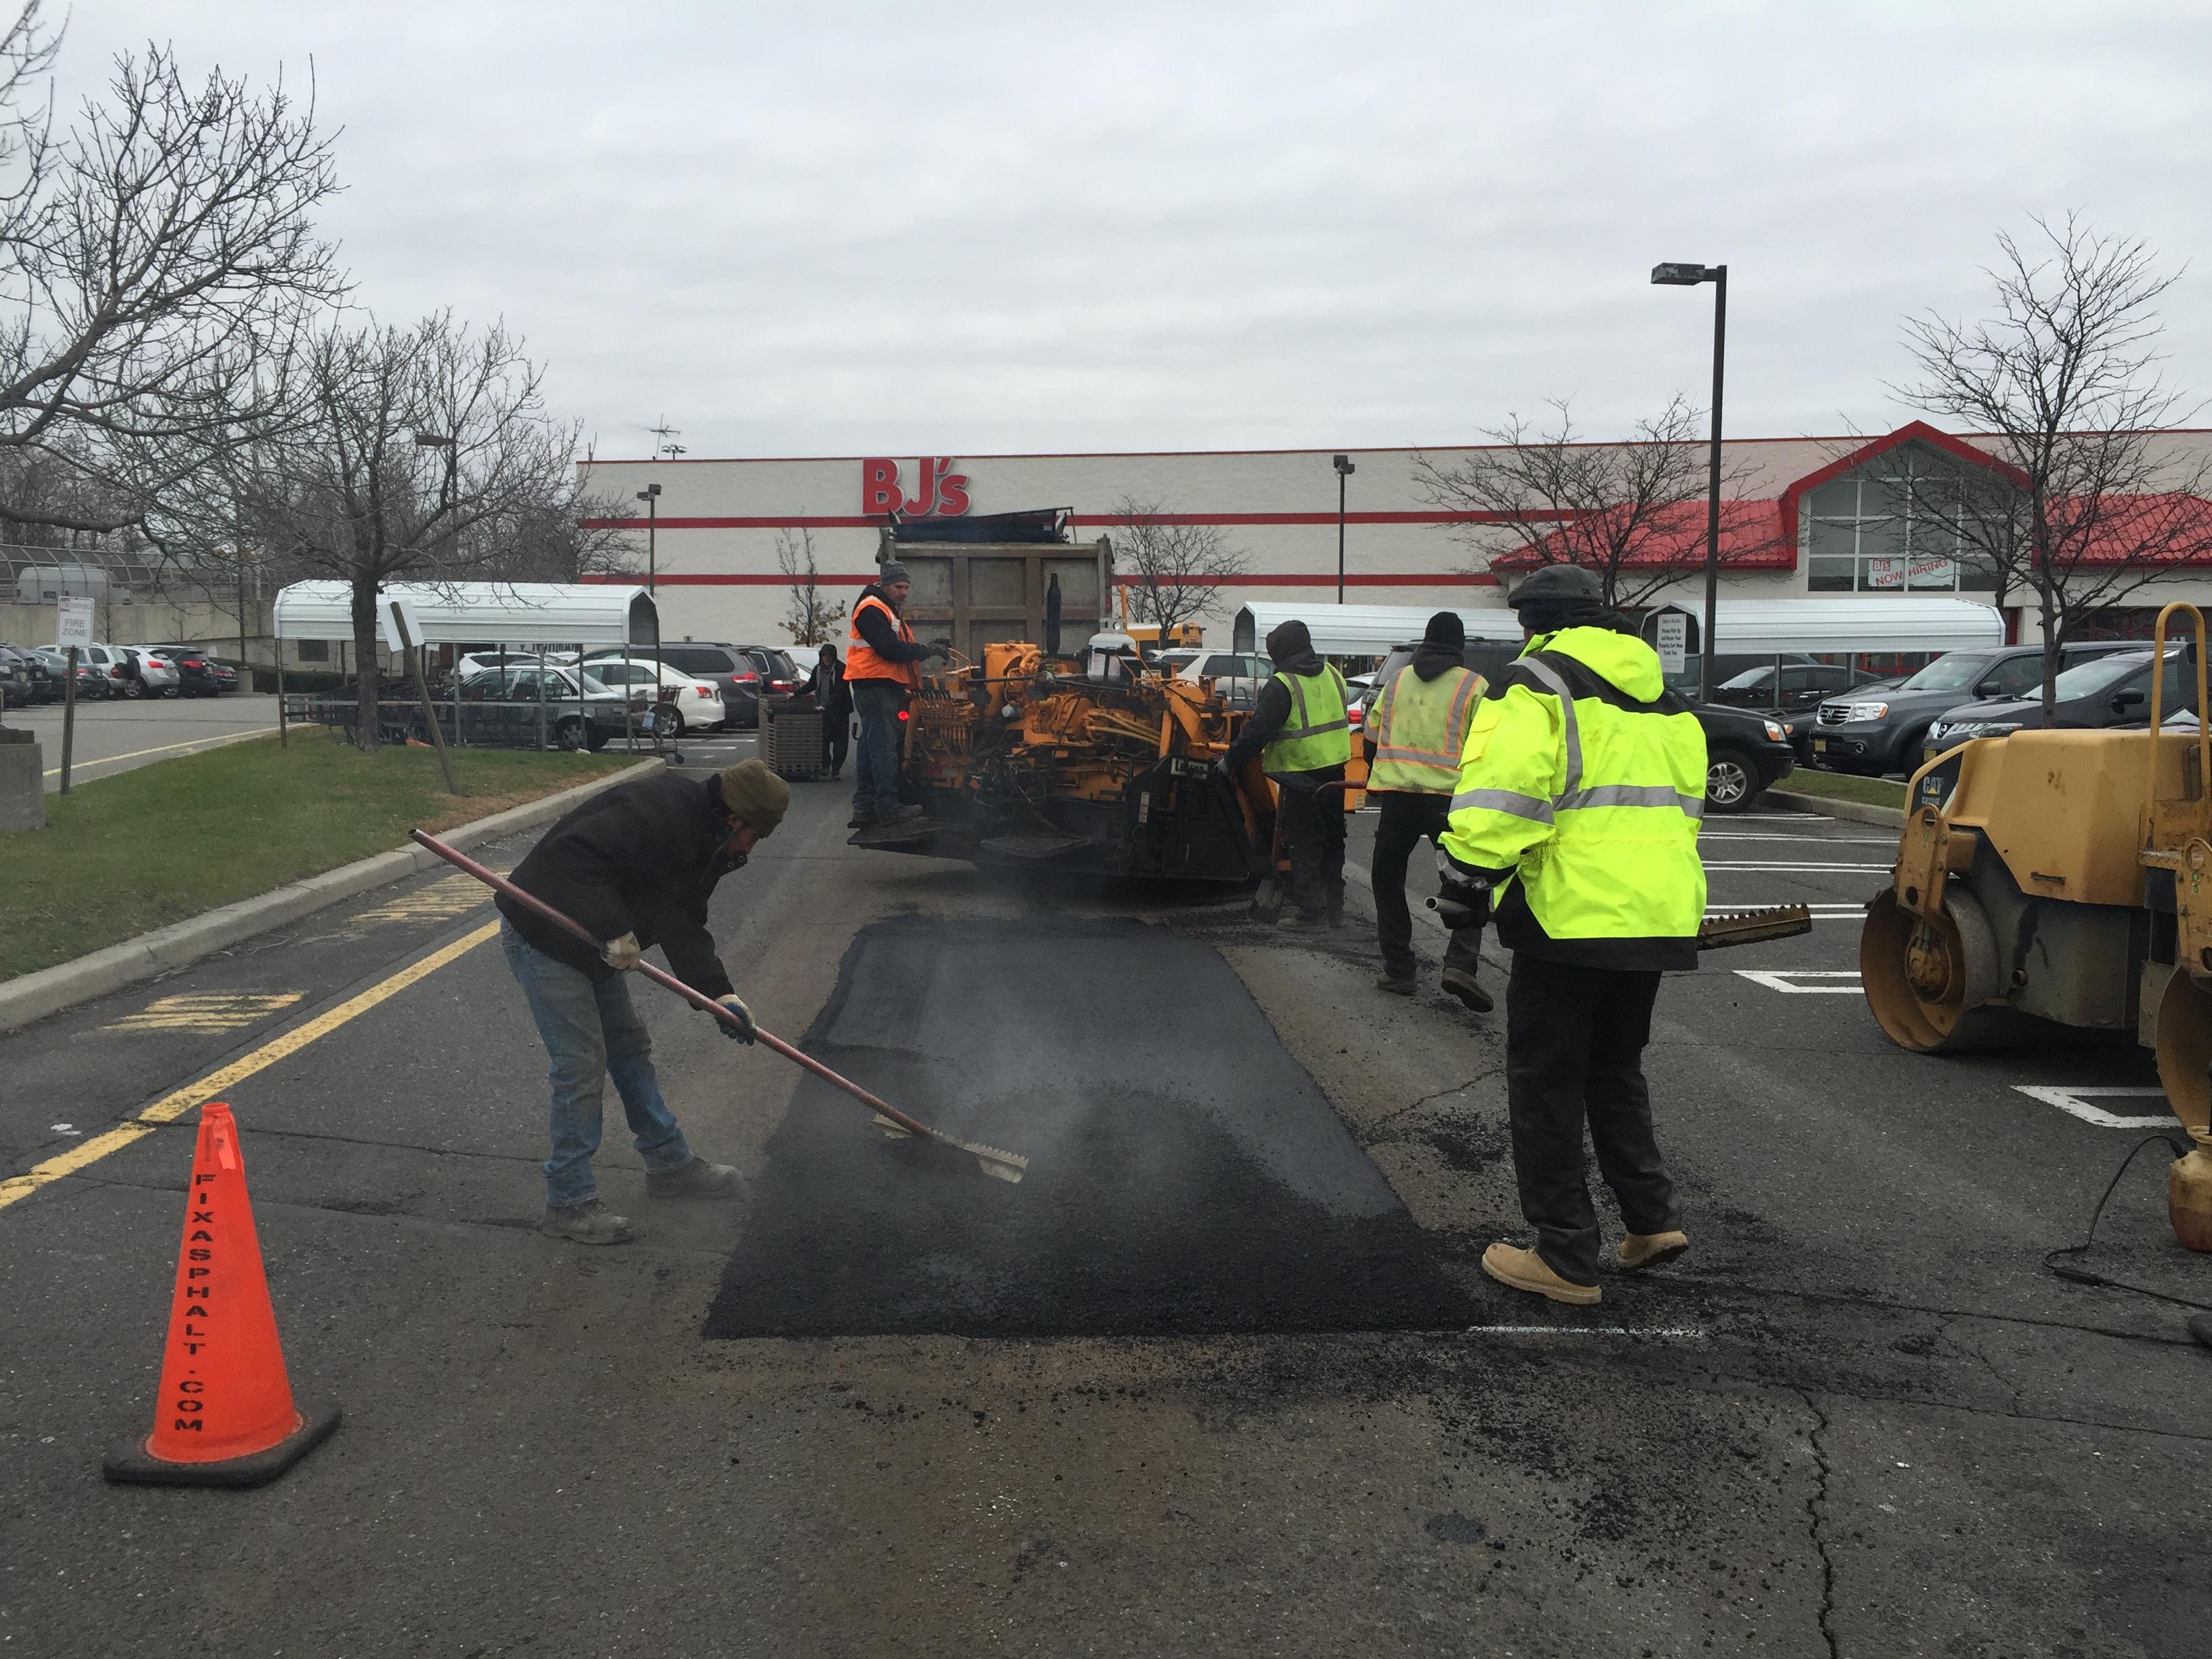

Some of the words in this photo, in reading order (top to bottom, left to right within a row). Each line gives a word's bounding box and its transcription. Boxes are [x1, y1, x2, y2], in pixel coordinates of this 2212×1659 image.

[863, 457, 970, 516] BJ's
[1874, 558, 1890, 571] BJ's
[1875, 571, 1902, 586] NOW
[1908, 558, 1948, 577] HIRING
[62, 628, 87, 637] ZONE
[64, 618, 85, 628] FIRE
[1923, 776, 1943, 795] CAT
[174, 1174, 216, 1432] FIXASPHALT.COM
